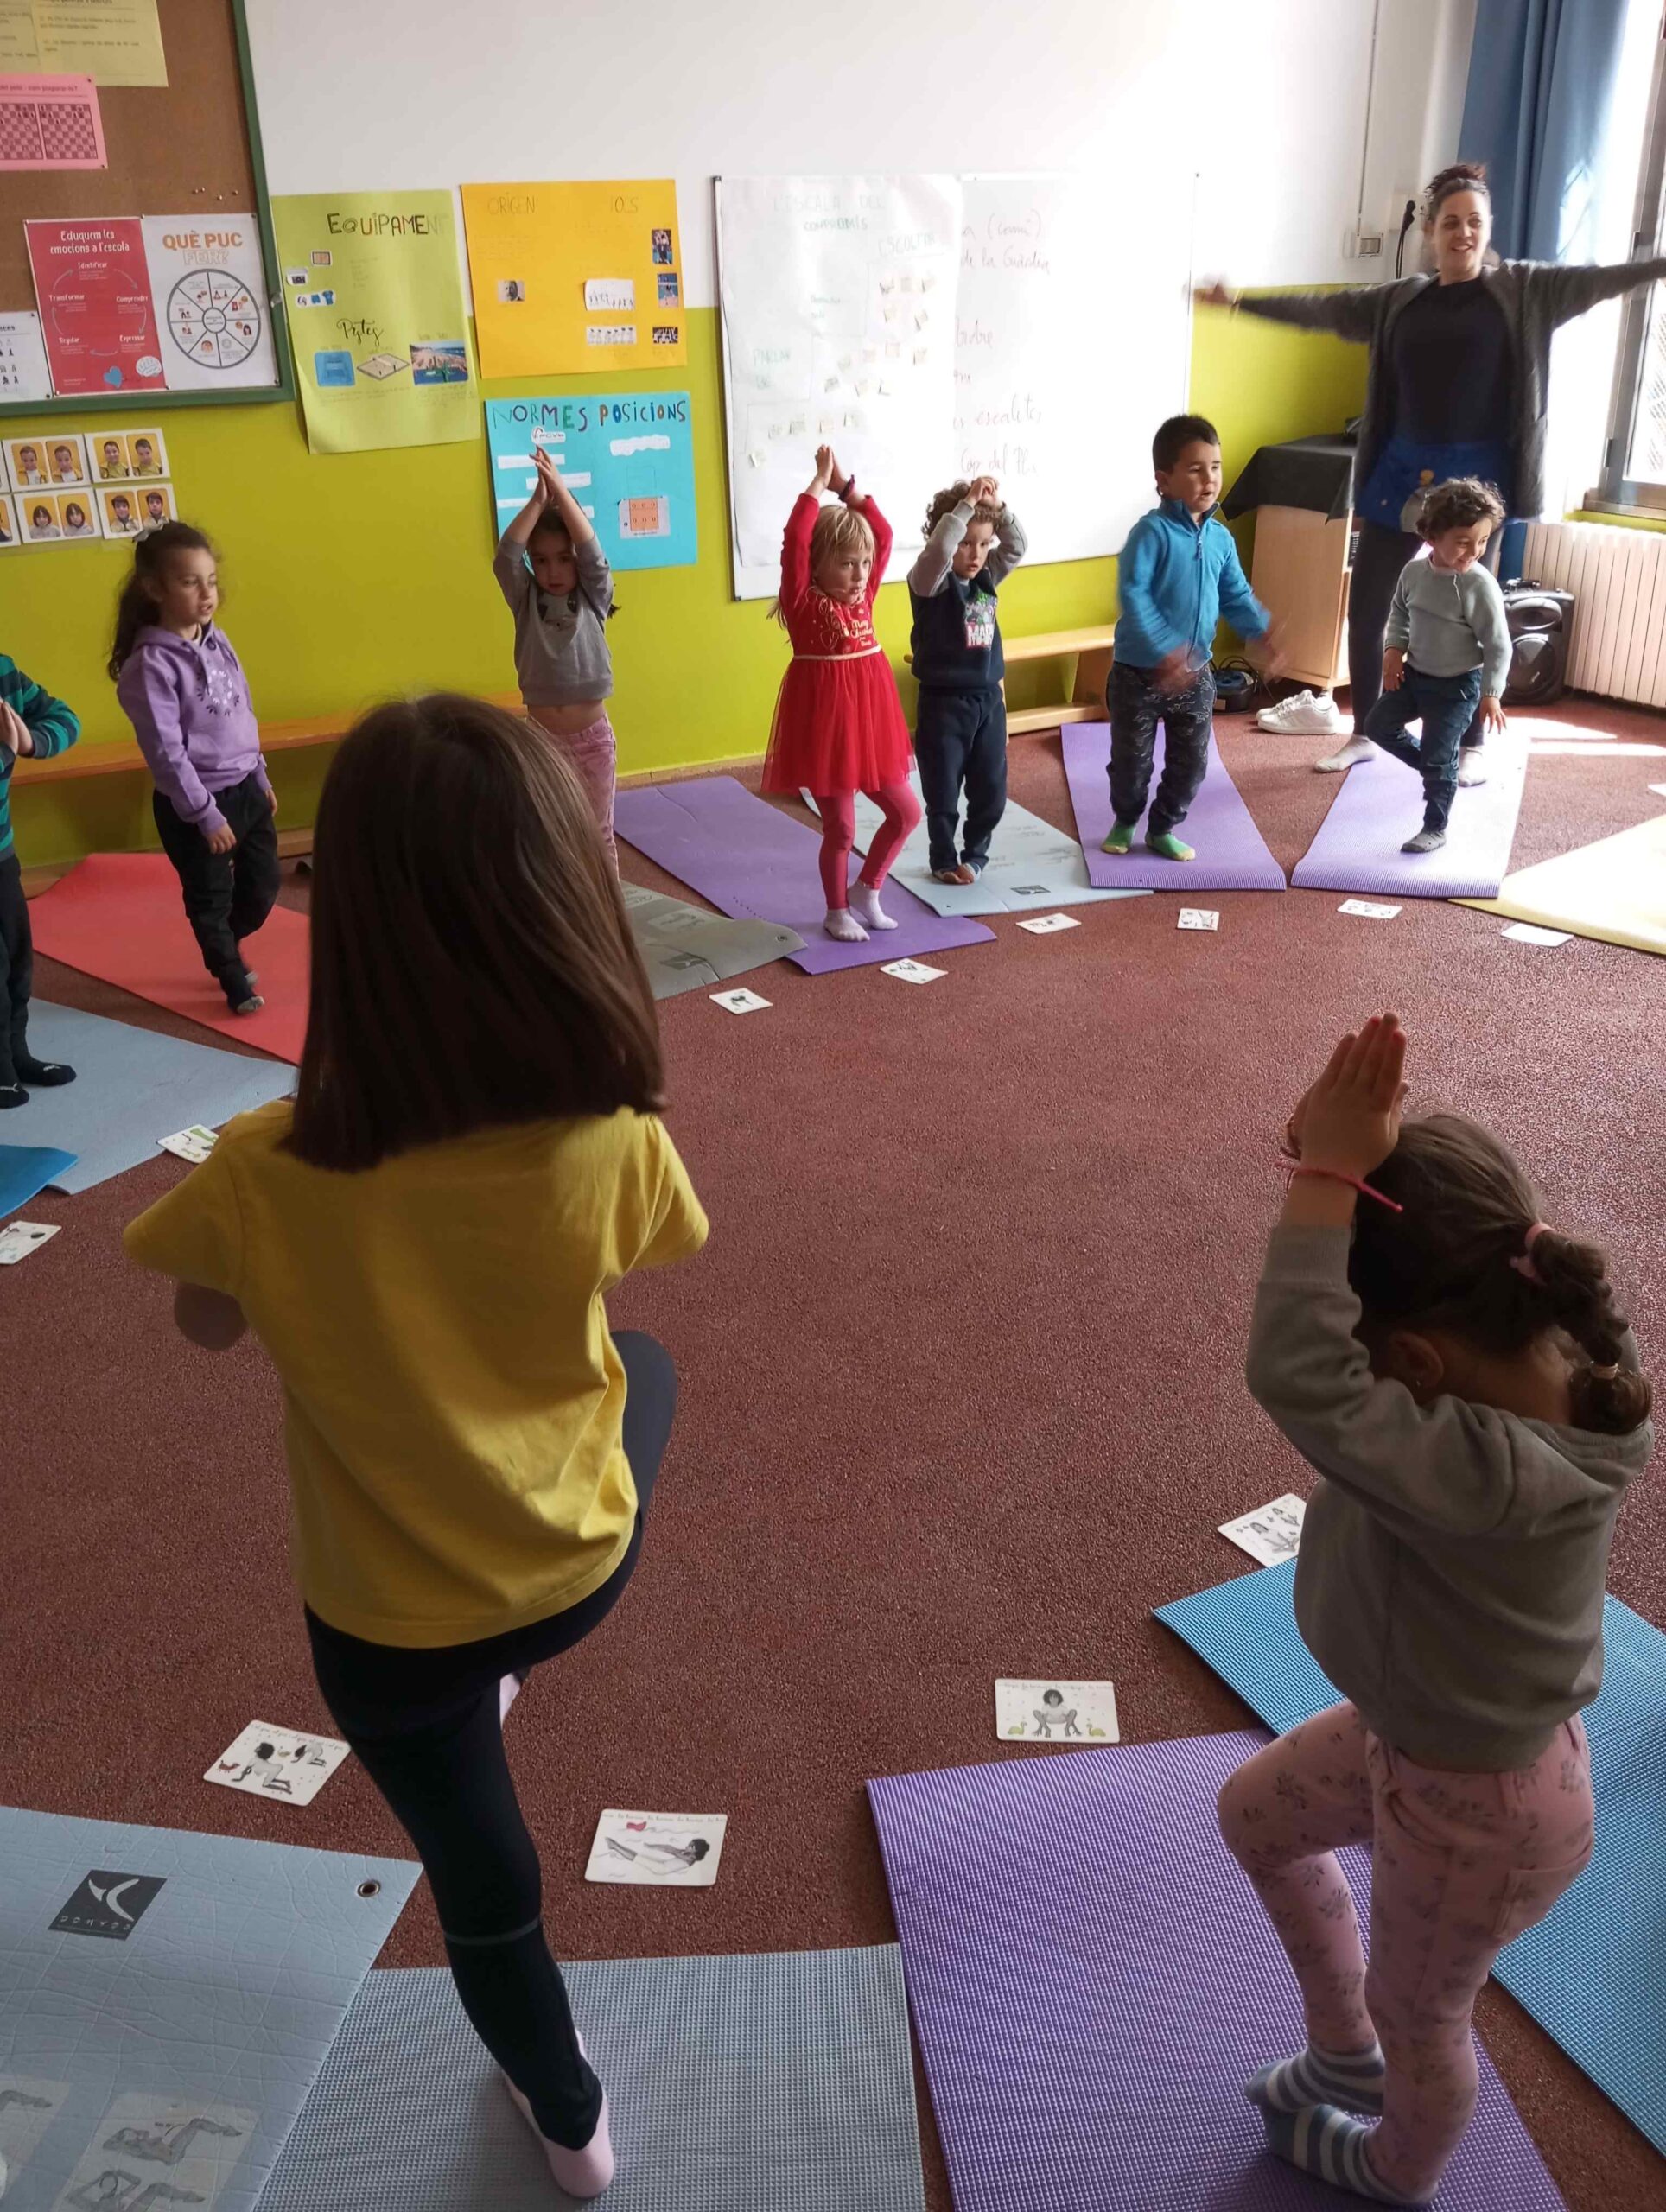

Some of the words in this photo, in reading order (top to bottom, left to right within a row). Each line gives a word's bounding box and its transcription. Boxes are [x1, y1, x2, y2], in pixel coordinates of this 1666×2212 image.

[60, 230, 101, 242] Eduquem
[103, 229, 115, 239] les
[162, 230, 200, 251] QUÈ
[204, 232, 243, 248] PUC
[50, 243, 90, 254] emocions
[493, 404, 588, 432] NORMES
